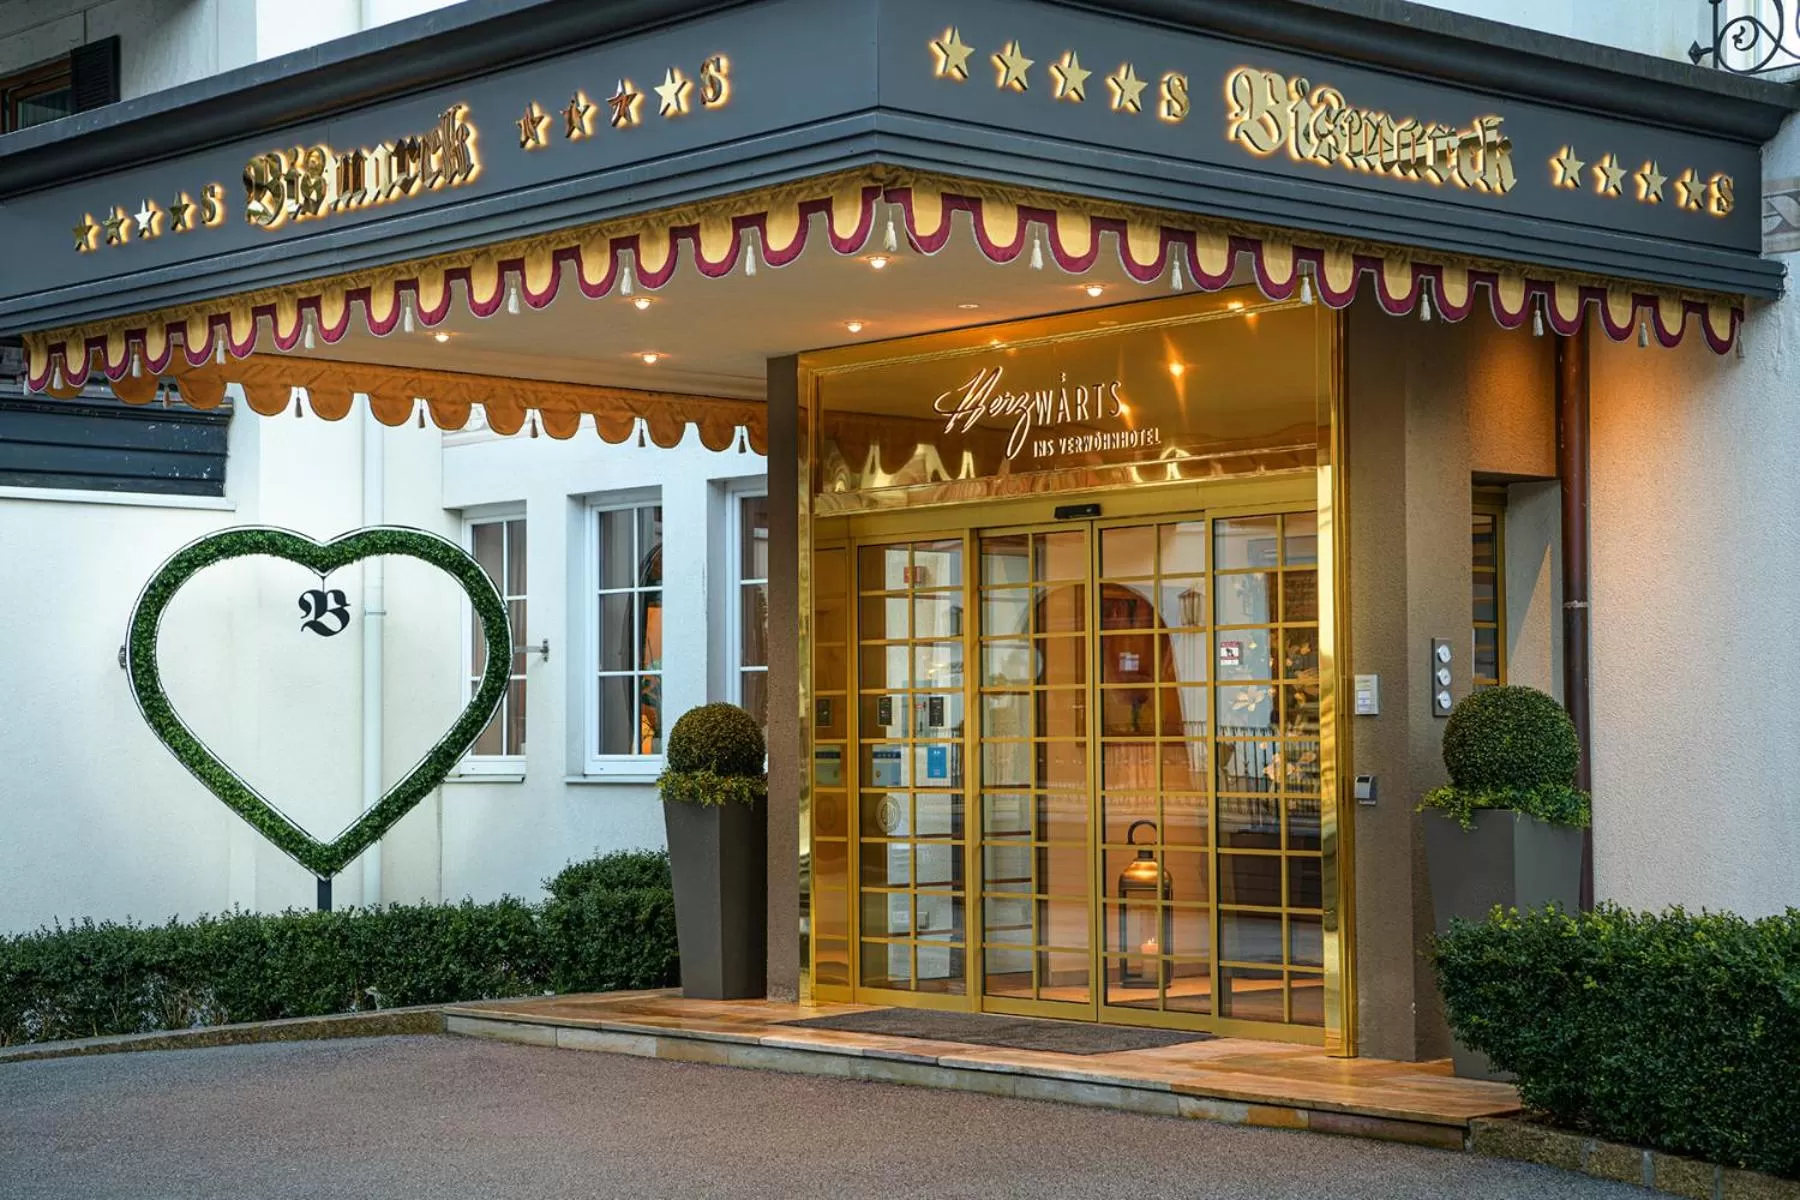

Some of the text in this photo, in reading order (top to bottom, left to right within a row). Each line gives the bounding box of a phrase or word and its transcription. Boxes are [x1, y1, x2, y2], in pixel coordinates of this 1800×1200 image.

[242, 103, 477, 229] Bismarck
[700, 55, 730, 110] S
[1160, 71, 1190, 120] S
[1226, 66, 1517, 194] Bismarck
[1033, 439, 1055, 458] INS
[298, 589, 351, 637] B
